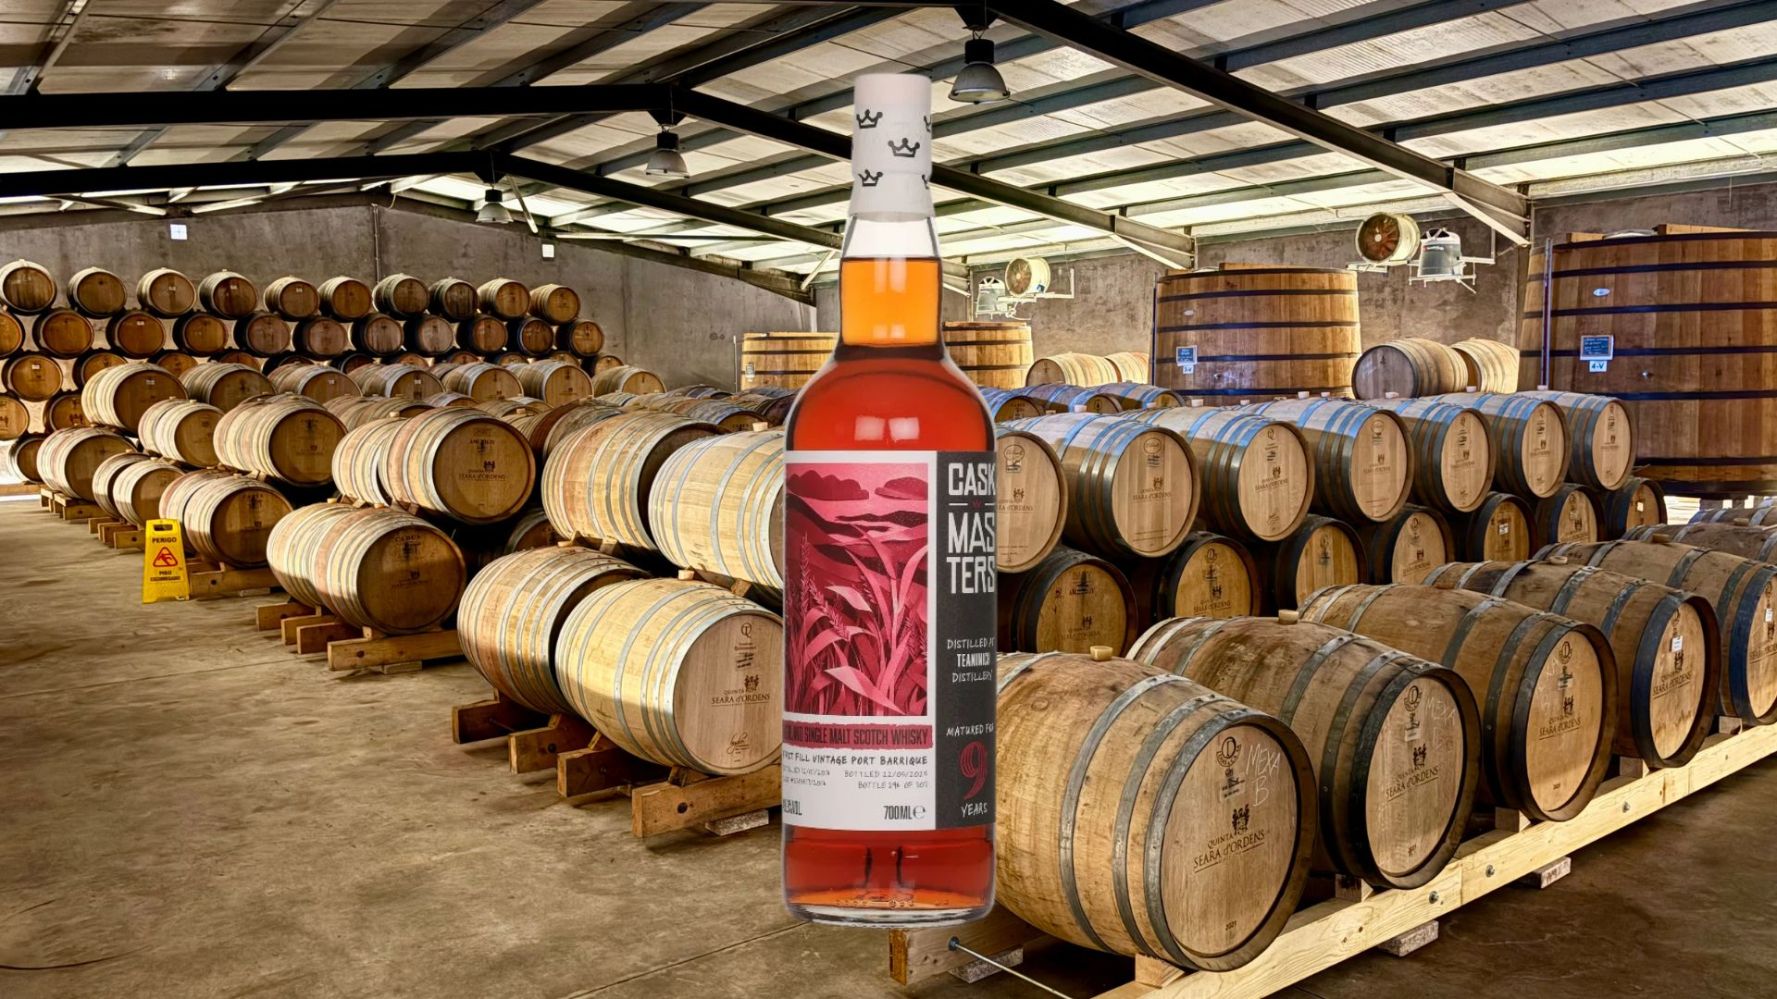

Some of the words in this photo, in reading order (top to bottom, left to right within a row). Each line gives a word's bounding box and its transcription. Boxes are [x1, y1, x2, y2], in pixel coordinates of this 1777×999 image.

[948, 462, 996, 496] CASK
[948, 512, 995, 554] MAS
[946, 556, 995, 594] TERS
[947, 638, 988, 649] DISTILLED
[804, 726, 828, 744] SINGLE
[829, 727, 851, 745] MALT
[853, 728, 889, 745] SCOTCH
[891, 728, 928, 745] WHISKY
[946, 725, 984, 737] MATURED
[795, 752, 810, 762] FILL
[812, 755, 847, 765] VINTAGE
[851, 756, 876, 765] PORT
[880, 755, 928, 766] BARRIQUE
[844, 770, 880, 778] BOTTLED
[959, 741, 989, 800] 9
[858, 781, 886, 789] BOTTLE
[883, 805, 912, 820] 700ML
[961, 801, 988, 818] YEARS
[1207, 833, 1234, 850] QUINTA
[1193, 848, 1222, 868] SEARA
